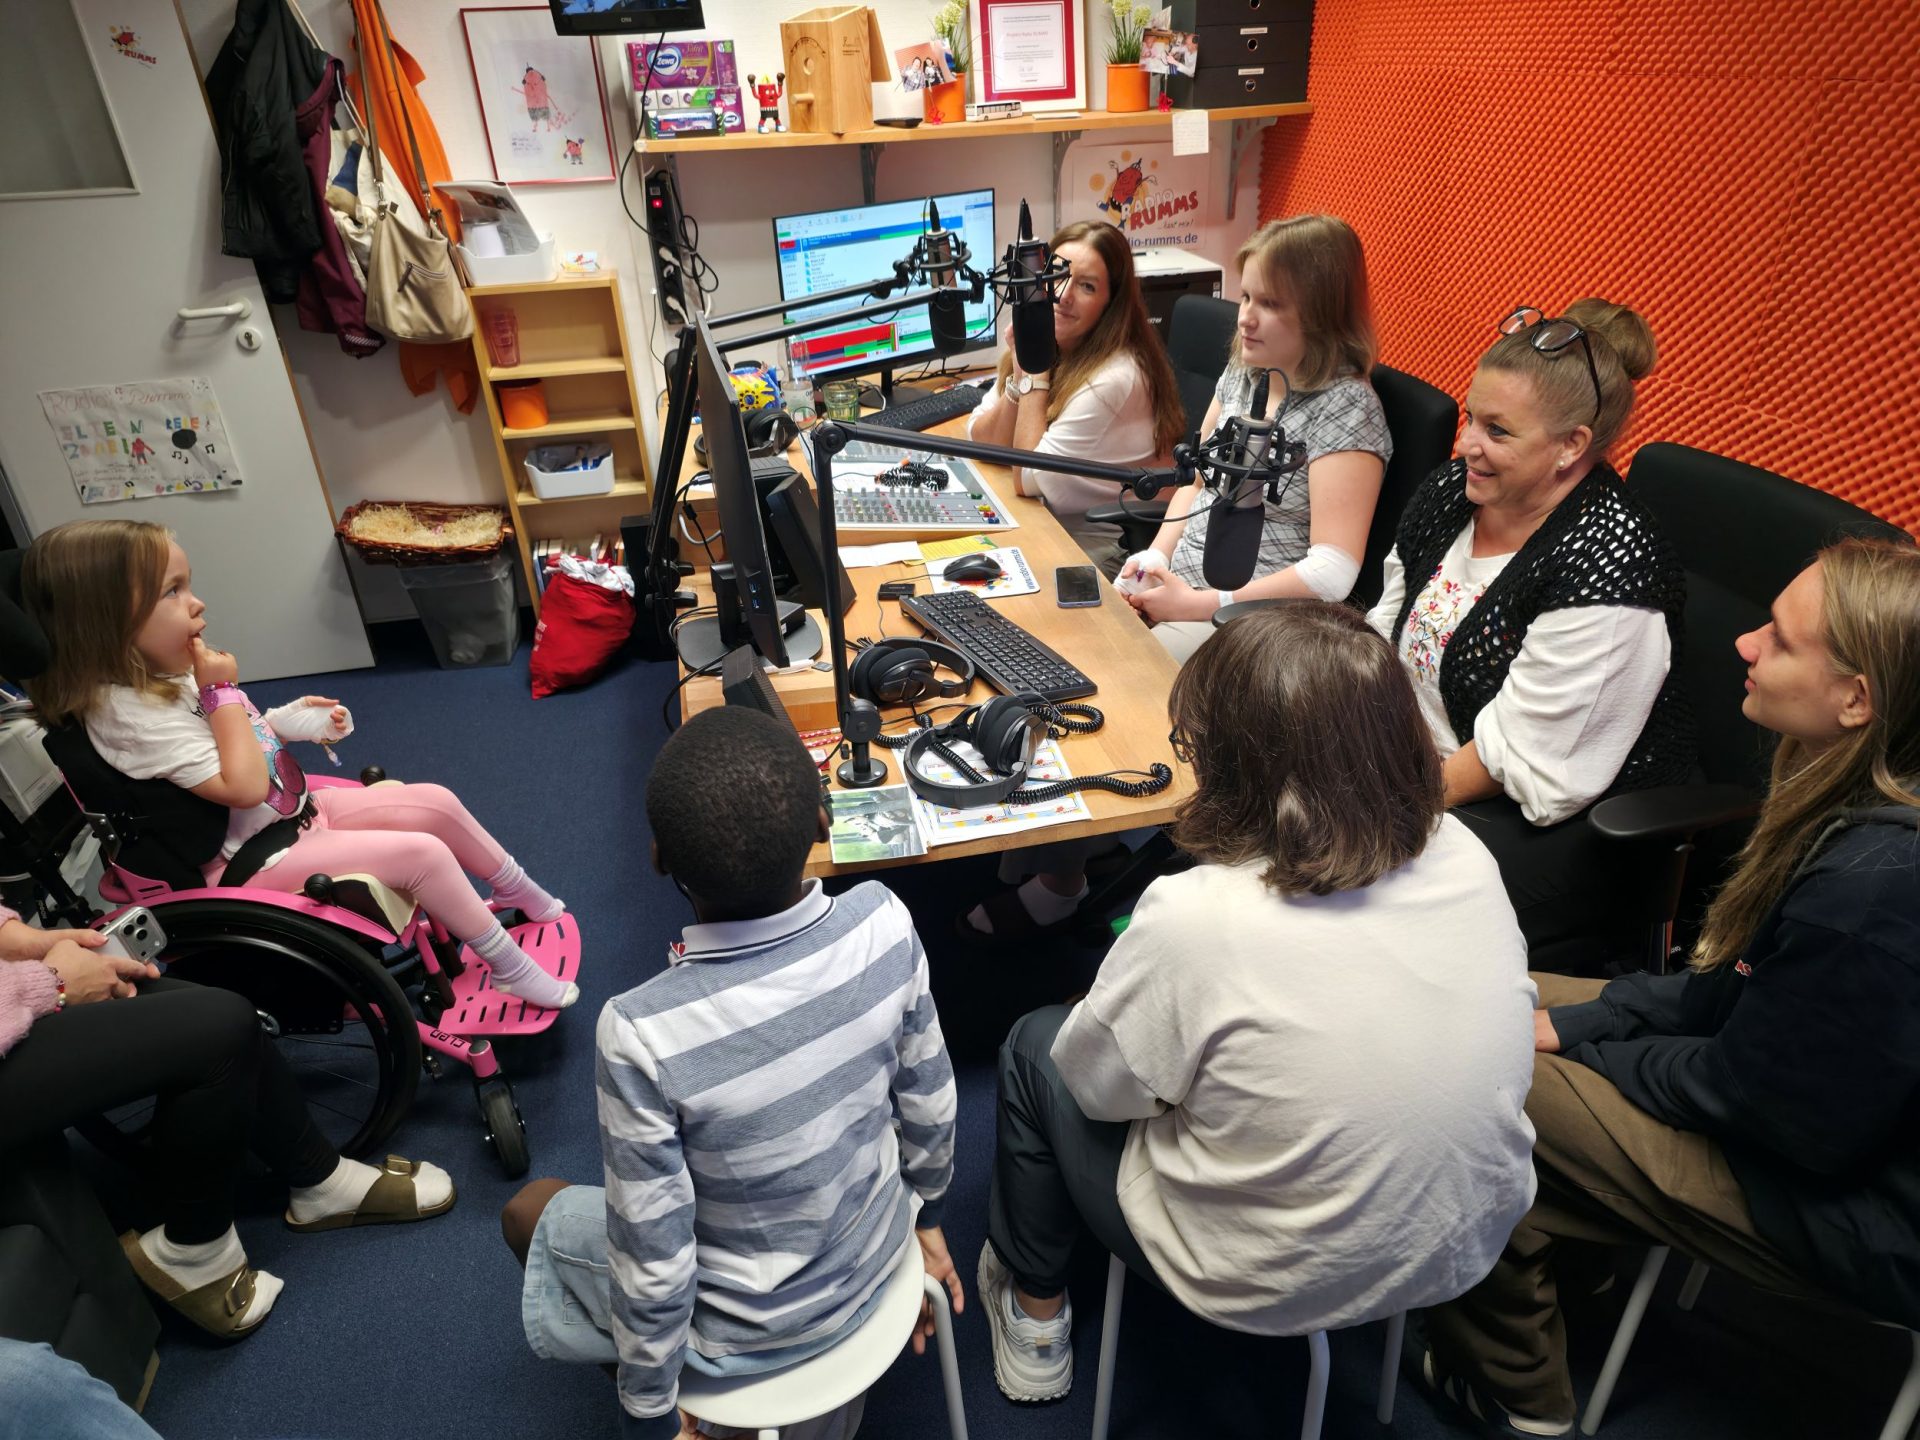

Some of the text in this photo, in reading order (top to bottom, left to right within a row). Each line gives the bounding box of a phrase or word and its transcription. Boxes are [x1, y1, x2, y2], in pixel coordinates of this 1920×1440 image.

[656, 57, 676, 66] Zewa
[1121, 189, 1174, 221] RADIO
[1130, 190, 1199, 231] RUMMS
